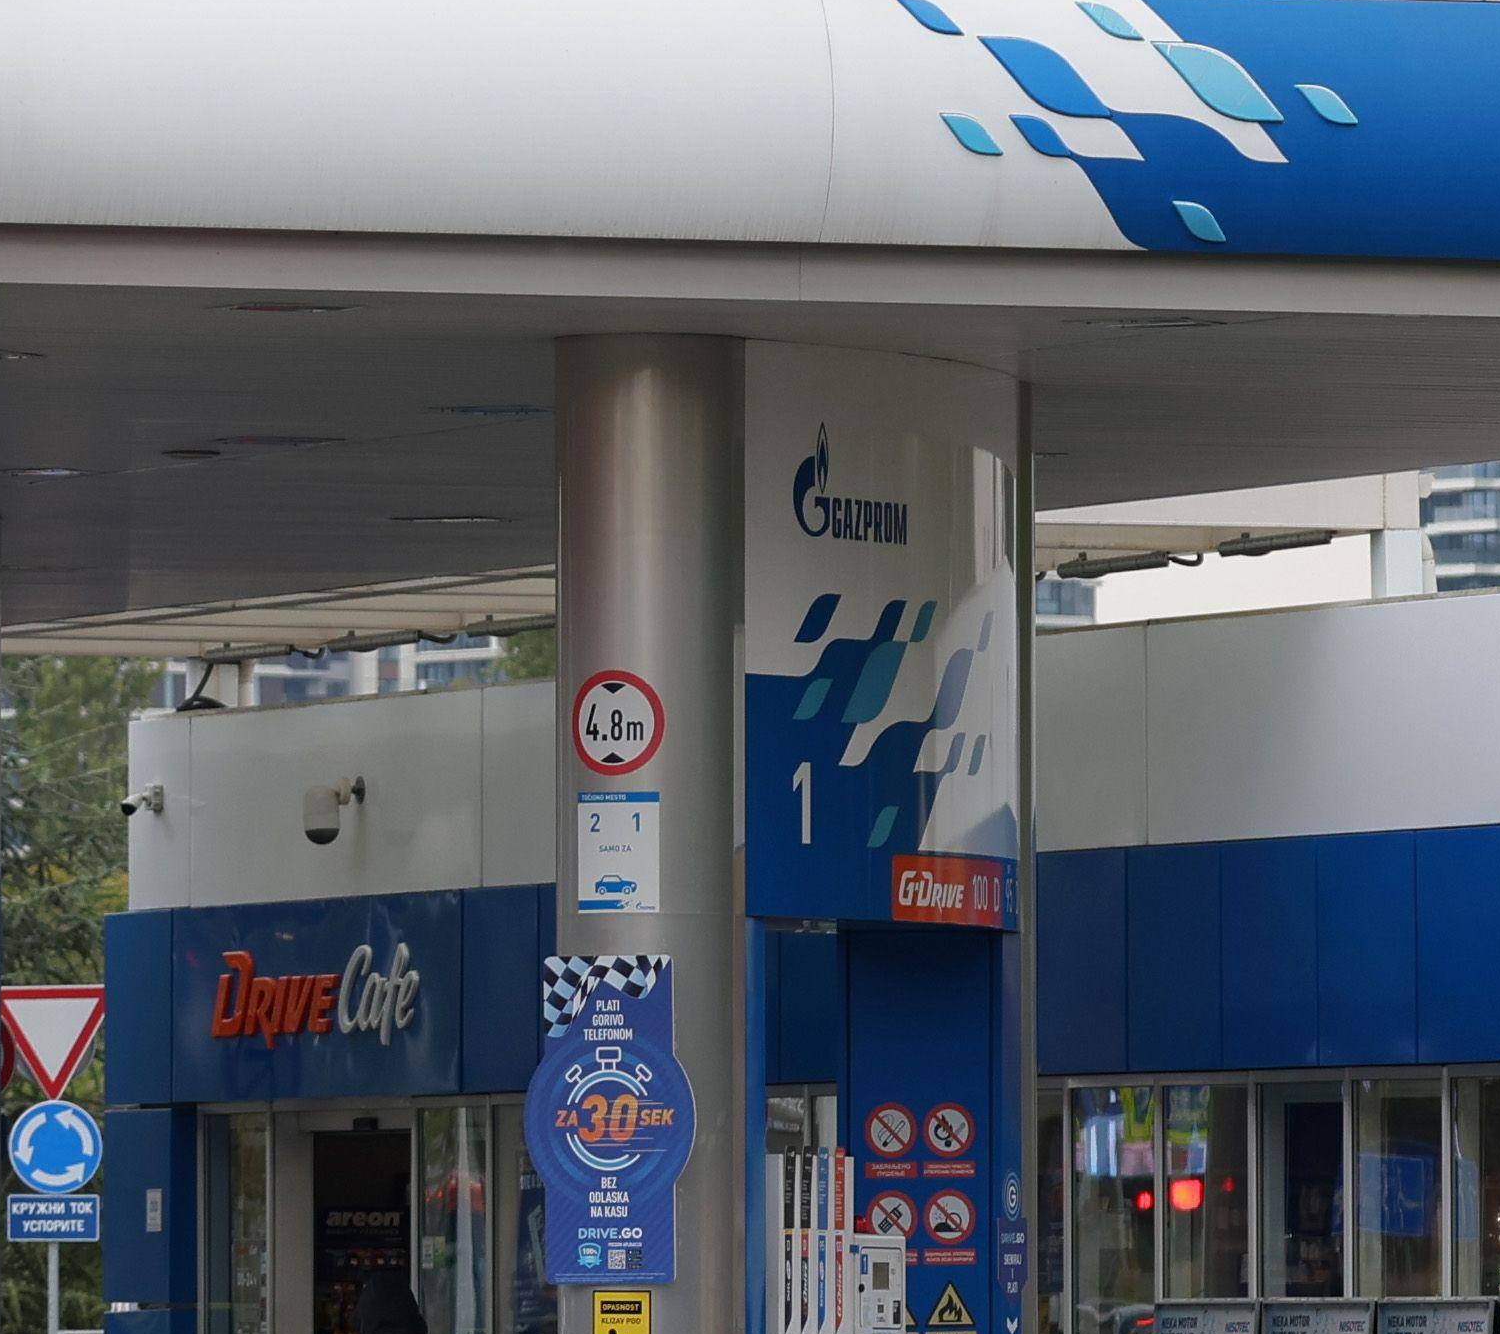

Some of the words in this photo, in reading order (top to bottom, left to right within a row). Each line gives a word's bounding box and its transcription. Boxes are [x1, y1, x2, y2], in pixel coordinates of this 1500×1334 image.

[831, 498, 907, 545] GAZPROM
[793, 761, 812, 844] 1
[590, 813, 600, 833] 2
[632, 812, 641, 832] 1
[599, 845, 620, 853] SAMO
[973, 875, 988, 911] 100
[211, 950, 339, 1048] DRIVE
[337, 941, 420, 1046] Cafe
[596, 1000, 620, 1012] PLATI
[592, 1014, 624, 1026] GORIVO
[583, 1028, 633, 1041] TELEFONOM
[555, 1110, 578, 1127] ZA
[578, 1094, 639, 1143] 30
[639, 1109, 675, 1126] SEK
[601, 1177, 617, 1188] BEZ
[589, 1191, 629, 1203] ODLASKA
[12, 1202, 65, 1215] КРУЖНИ
[70, 1202, 93, 1214] ТОК
[590, 1206, 603, 1218] NA
[604, 1206, 628, 1217] KASU
[326, 1211, 400, 1227] areon
[23, 1220, 85, 1233] УСПОРИТЕ
[578, 1227, 643, 1240] DRIVE.GO
[602, 1303, 640, 1312] OPASNOST
[1178, 1316, 1198, 1328] MOTOR
[1289, 1315, 1310, 1327] MOTOR
[1406, 1316, 1427, 1327] MOTOR
